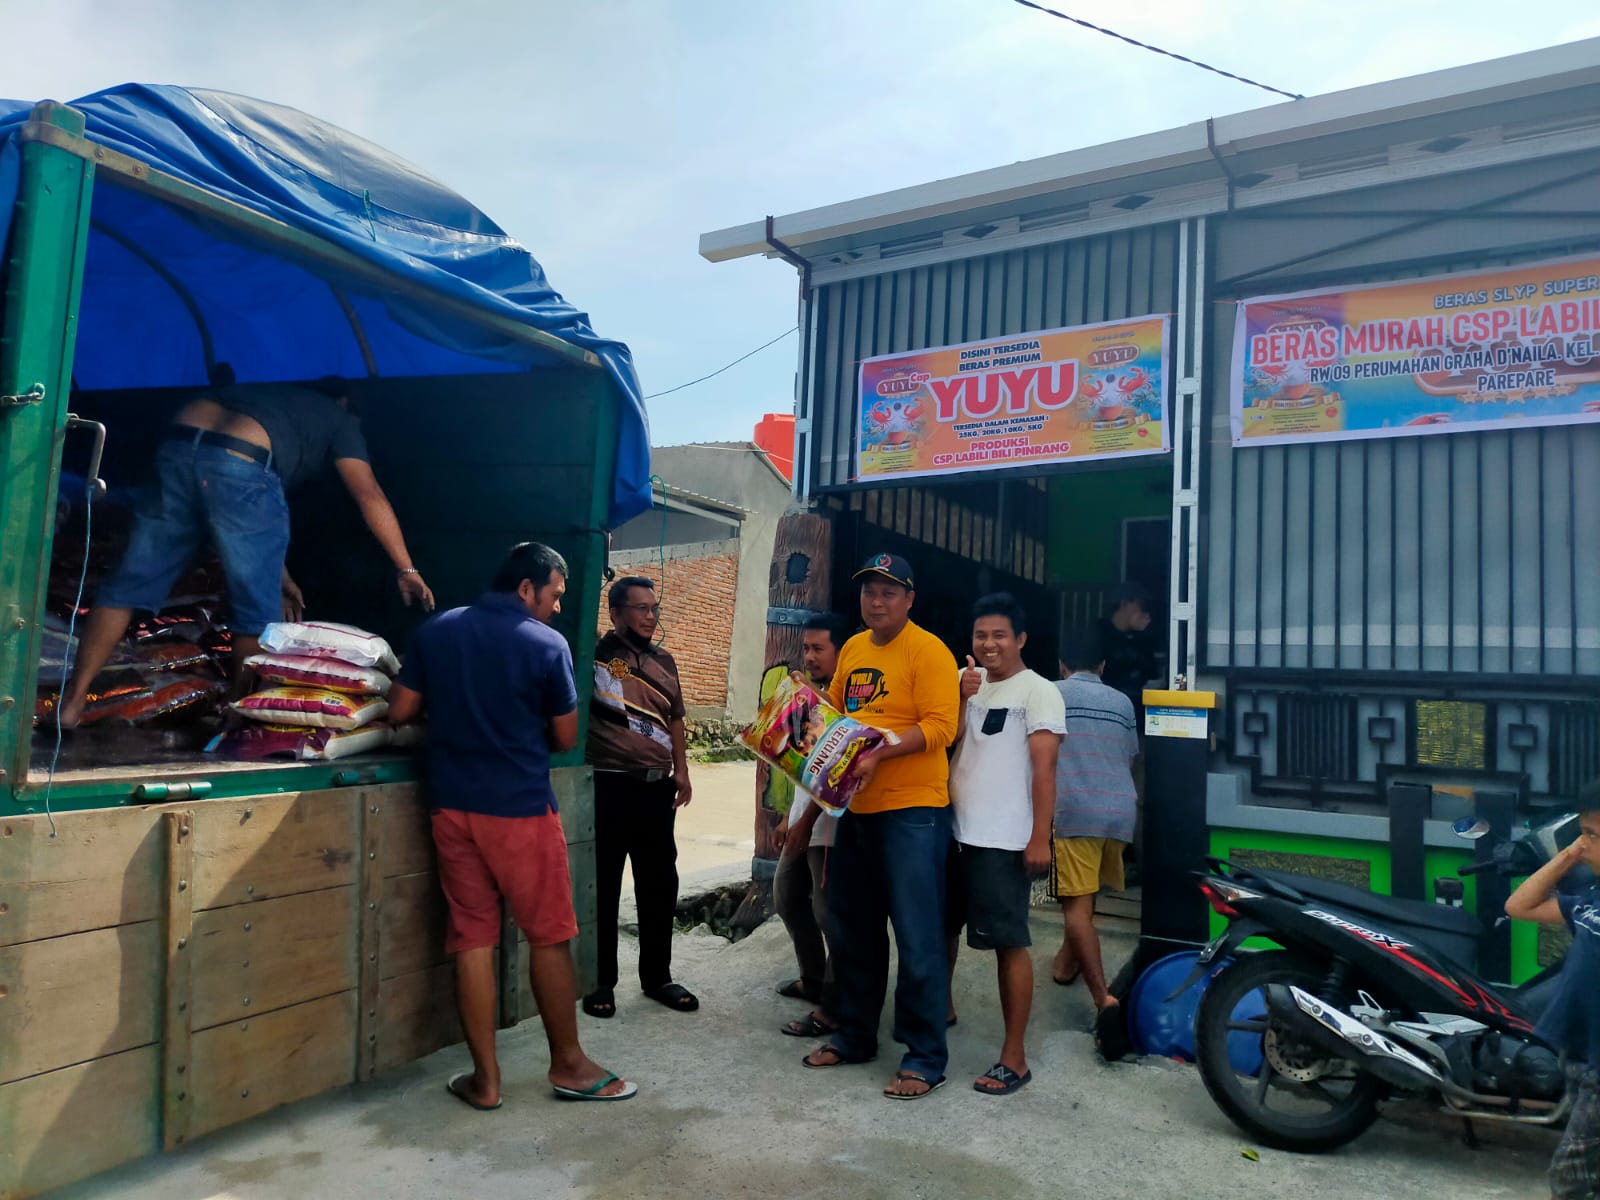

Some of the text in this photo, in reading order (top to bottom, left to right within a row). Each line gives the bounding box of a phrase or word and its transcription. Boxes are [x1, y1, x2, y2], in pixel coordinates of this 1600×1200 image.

[1434, 290, 1488, 309] BERAS
[1543, 275, 1599, 296] SUPER
[1252, 328, 1338, 366] BERAS
[1343, 316, 1444, 356] MURAH
[1452, 309, 1511, 344] CSP
[960, 340, 1040, 360] DISINI TERSEDIA
[1310, 366, 1330, 382] RW
[1333, 364, 1351, 381] 09
[1354, 356, 1440, 379] PERUMAHAN
[1444, 350, 1493, 371] GRAHA
[1566, 340, 1599, 359] KEL.
[959, 352, 1042, 372] BERAS PREMIUM
[910, 360, 1077, 420] Cap YUYU
[1477, 369, 1555, 392] PAREPARE
[953, 421, 983, 431] TERSEDIA
[984, 419, 1009, 428] DALAM
[1010, 415, 1045, 425] KEMASAN
[933, 442, 1070, 465] CSP LABILI BILI PINRANG
[970, 437, 1029, 451] PRODUKSI
[808, 725, 849, 776] BERUANG
